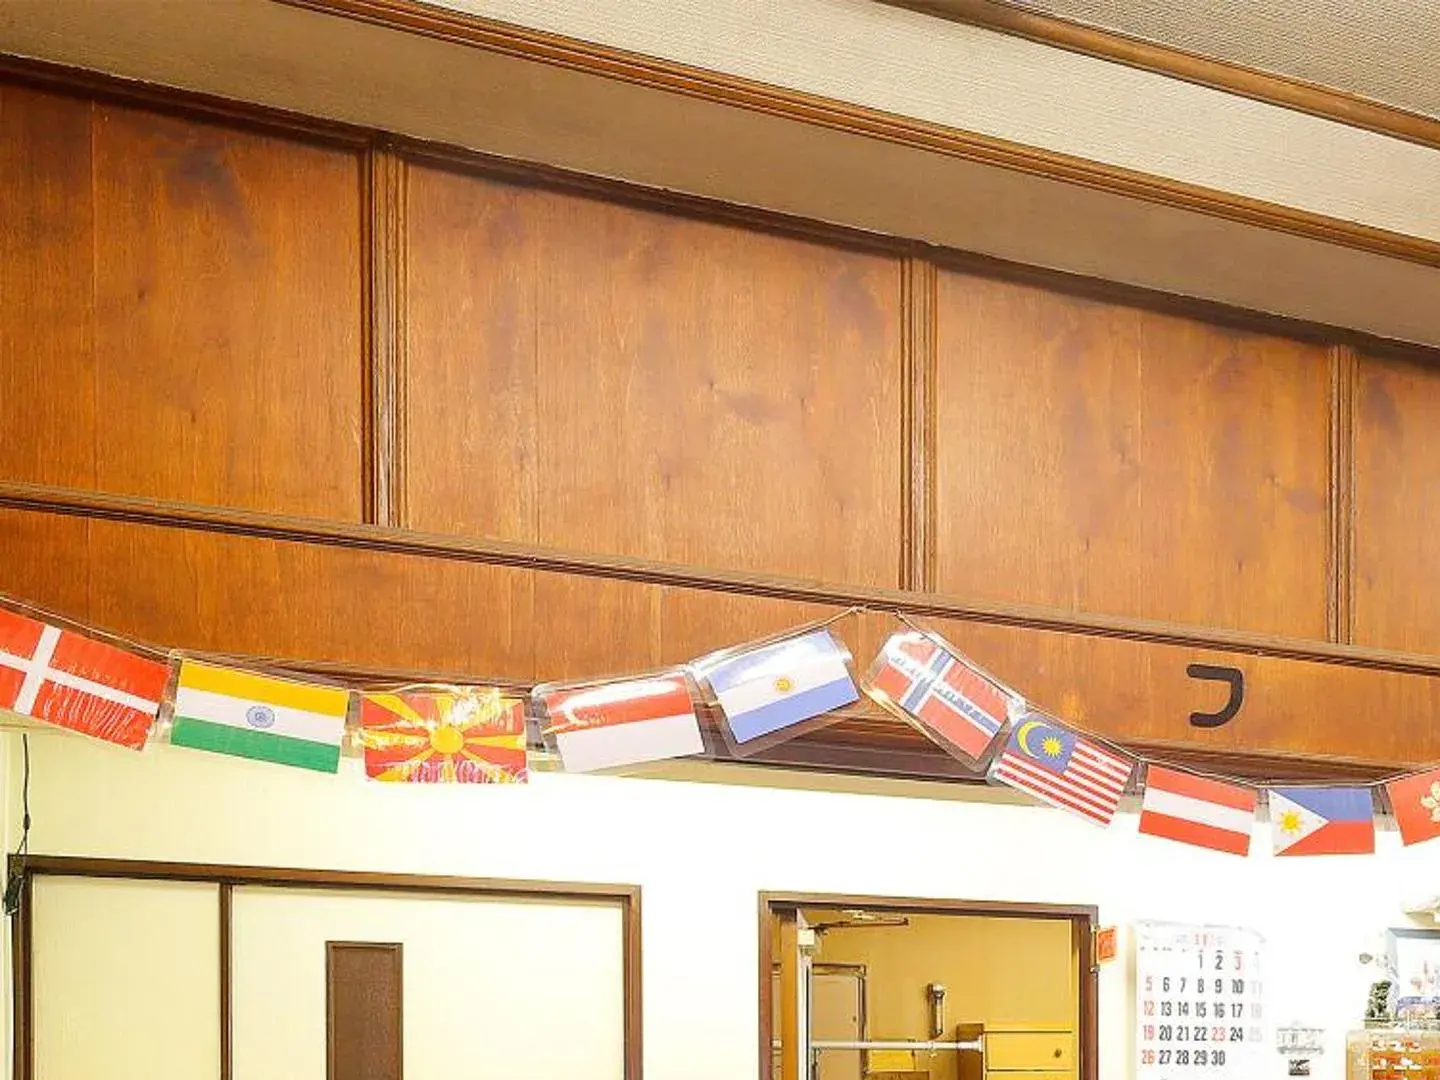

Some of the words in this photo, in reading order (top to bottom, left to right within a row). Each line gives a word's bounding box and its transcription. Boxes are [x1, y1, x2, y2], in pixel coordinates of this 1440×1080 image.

[1215, 954, 1224, 970] 2
[1163, 976, 1170, 992] 6
[1180, 977, 1187, 993] 7
[1214, 978, 1222, 994] 9
[1231, 978, 1244, 994] 10
[1143, 1001, 1154, 1016] 12
[1161, 1001, 1172, 1017] 13
[1178, 1001, 1189, 1017] 14
[1195, 1002, 1206, 1018] 15
[1213, 1003, 1225, 1018] 16
[1231, 1003, 1243, 1018] 17
[1143, 1025, 1155, 1041] 19
[1159, 1025, 1172, 1041] 20
[1177, 1025, 1189, 1041] 21
[1194, 1026, 1208, 1042] 22
[1211, 1026, 1226, 1042] 23
[1229, 1026, 1243, 1042] 24
[1141, 1049, 1155, 1065] 26
[1158, 1049, 1172, 1065] 27
[1175, 1049, 1189, 1065] 28
[1193, 1050, 1208, 1066] 29
[1211, 1050, 1226, 1066] 30
